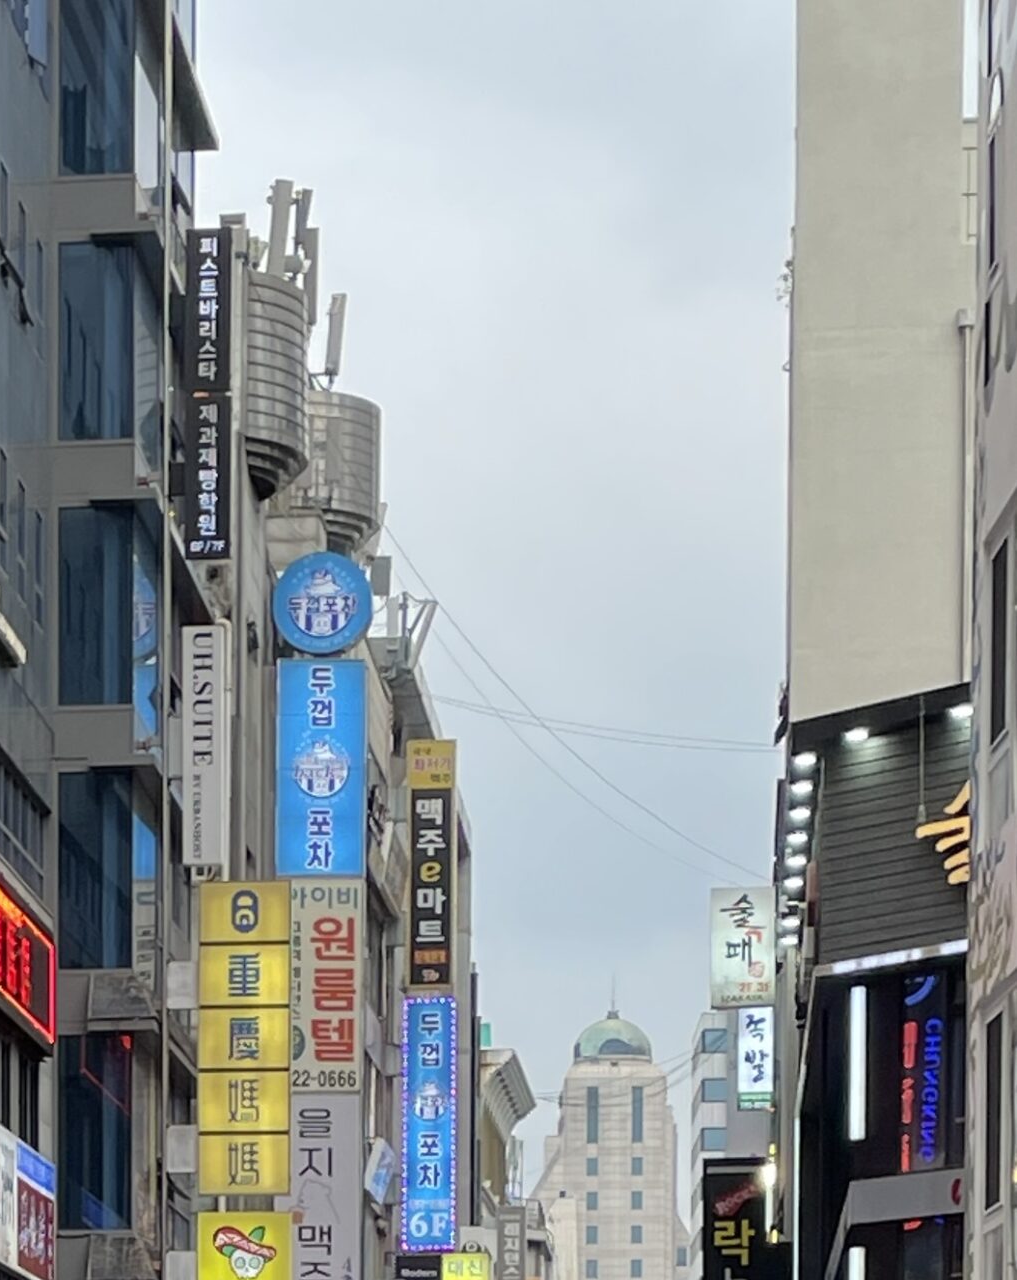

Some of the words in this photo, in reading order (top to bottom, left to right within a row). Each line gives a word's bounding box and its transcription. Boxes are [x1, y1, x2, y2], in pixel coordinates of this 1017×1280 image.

[309, 916, 357, 1063] 원룸텔
[409, 1211, 449, 1239] 6F
[448, 1260, 482, 1277] 대신
